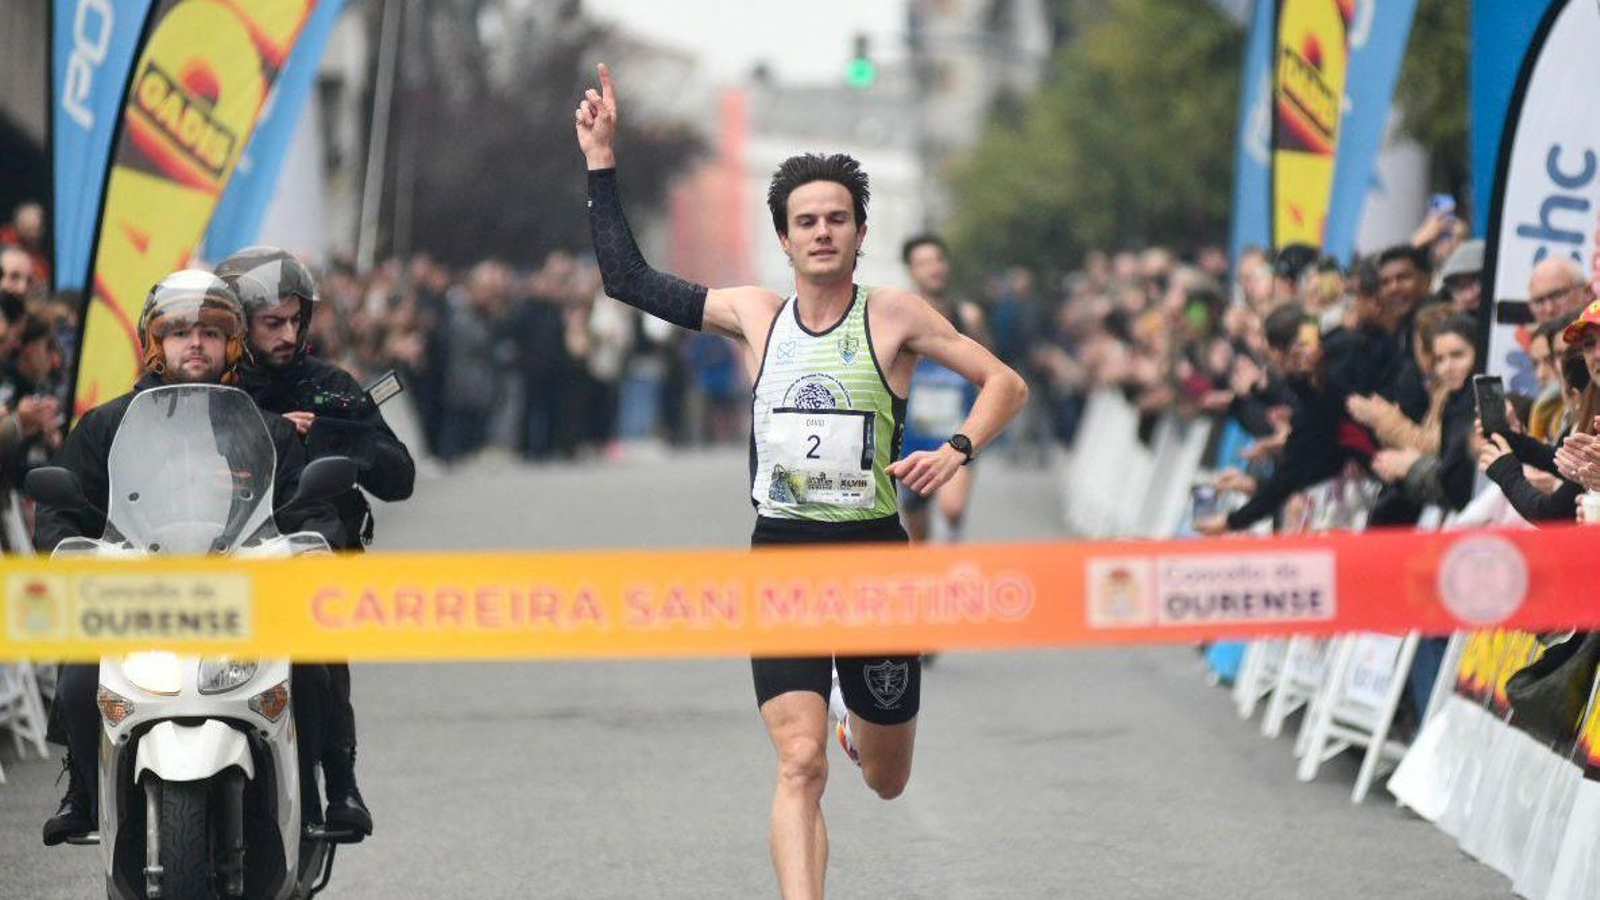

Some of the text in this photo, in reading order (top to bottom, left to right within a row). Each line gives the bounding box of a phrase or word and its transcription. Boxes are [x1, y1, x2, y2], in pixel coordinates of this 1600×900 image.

[806, 435, 821, 459] 2
[310, 563, 1035, 630] CARREIRA SAN MARTIÑO
[1166, 588, 1322, 619] OURENSE
[81, 609, 241, 636] OURENSE
